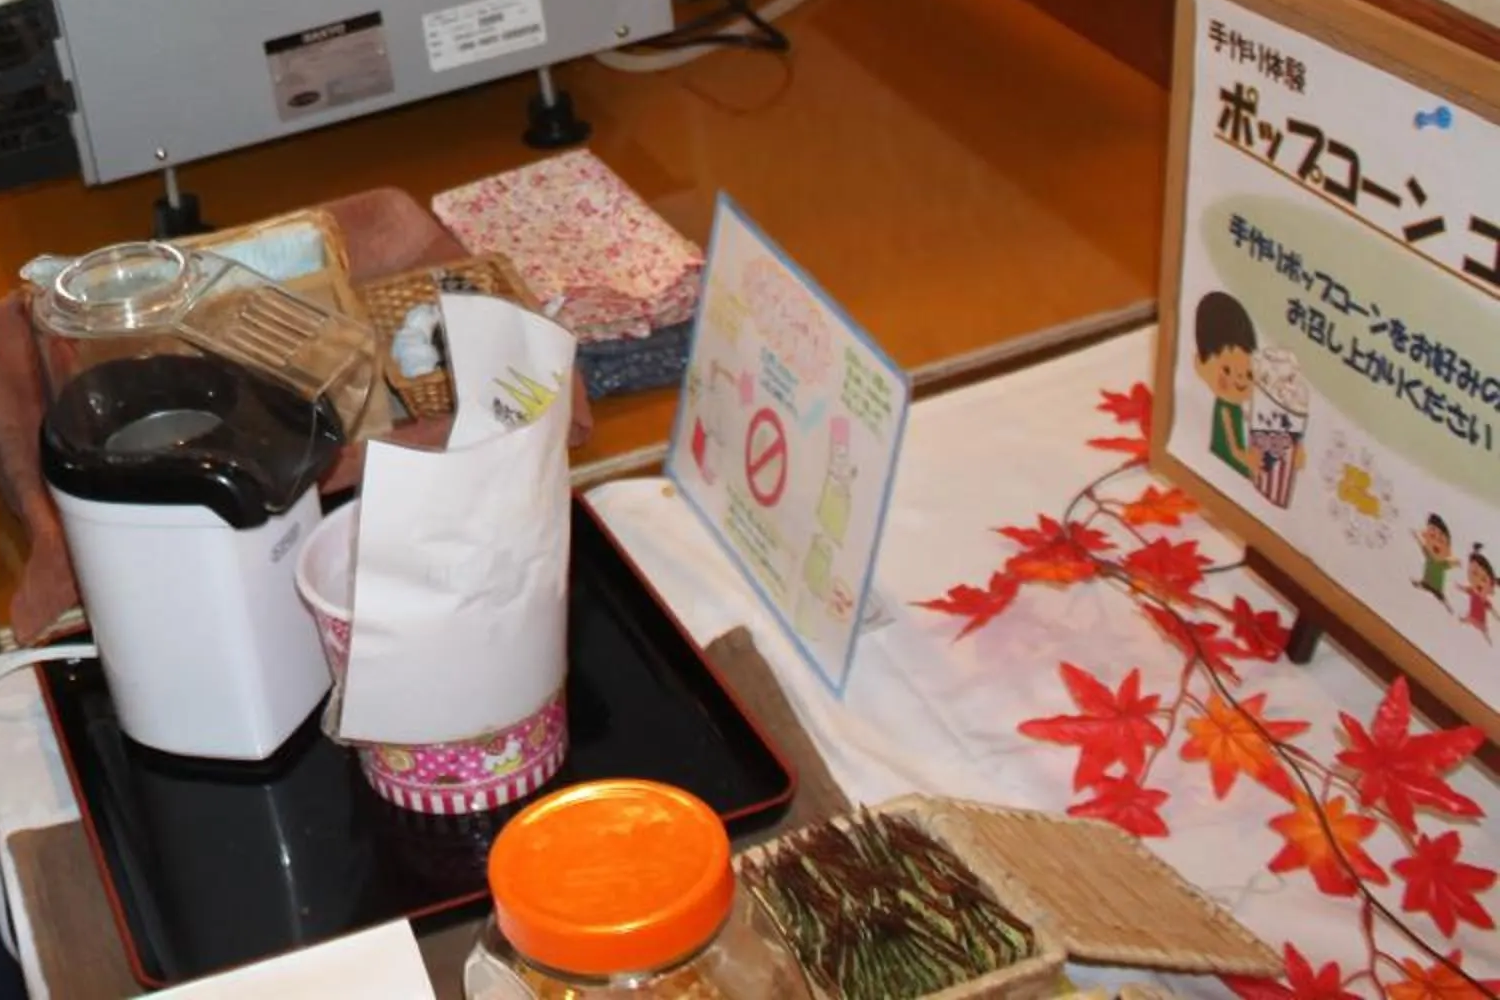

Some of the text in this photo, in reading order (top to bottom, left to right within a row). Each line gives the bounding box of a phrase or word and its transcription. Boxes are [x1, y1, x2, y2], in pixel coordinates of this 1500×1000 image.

[1208, 19, 1306, 95] 手作り体験
[1286, 298, 1493, 451] お召し上がりください
